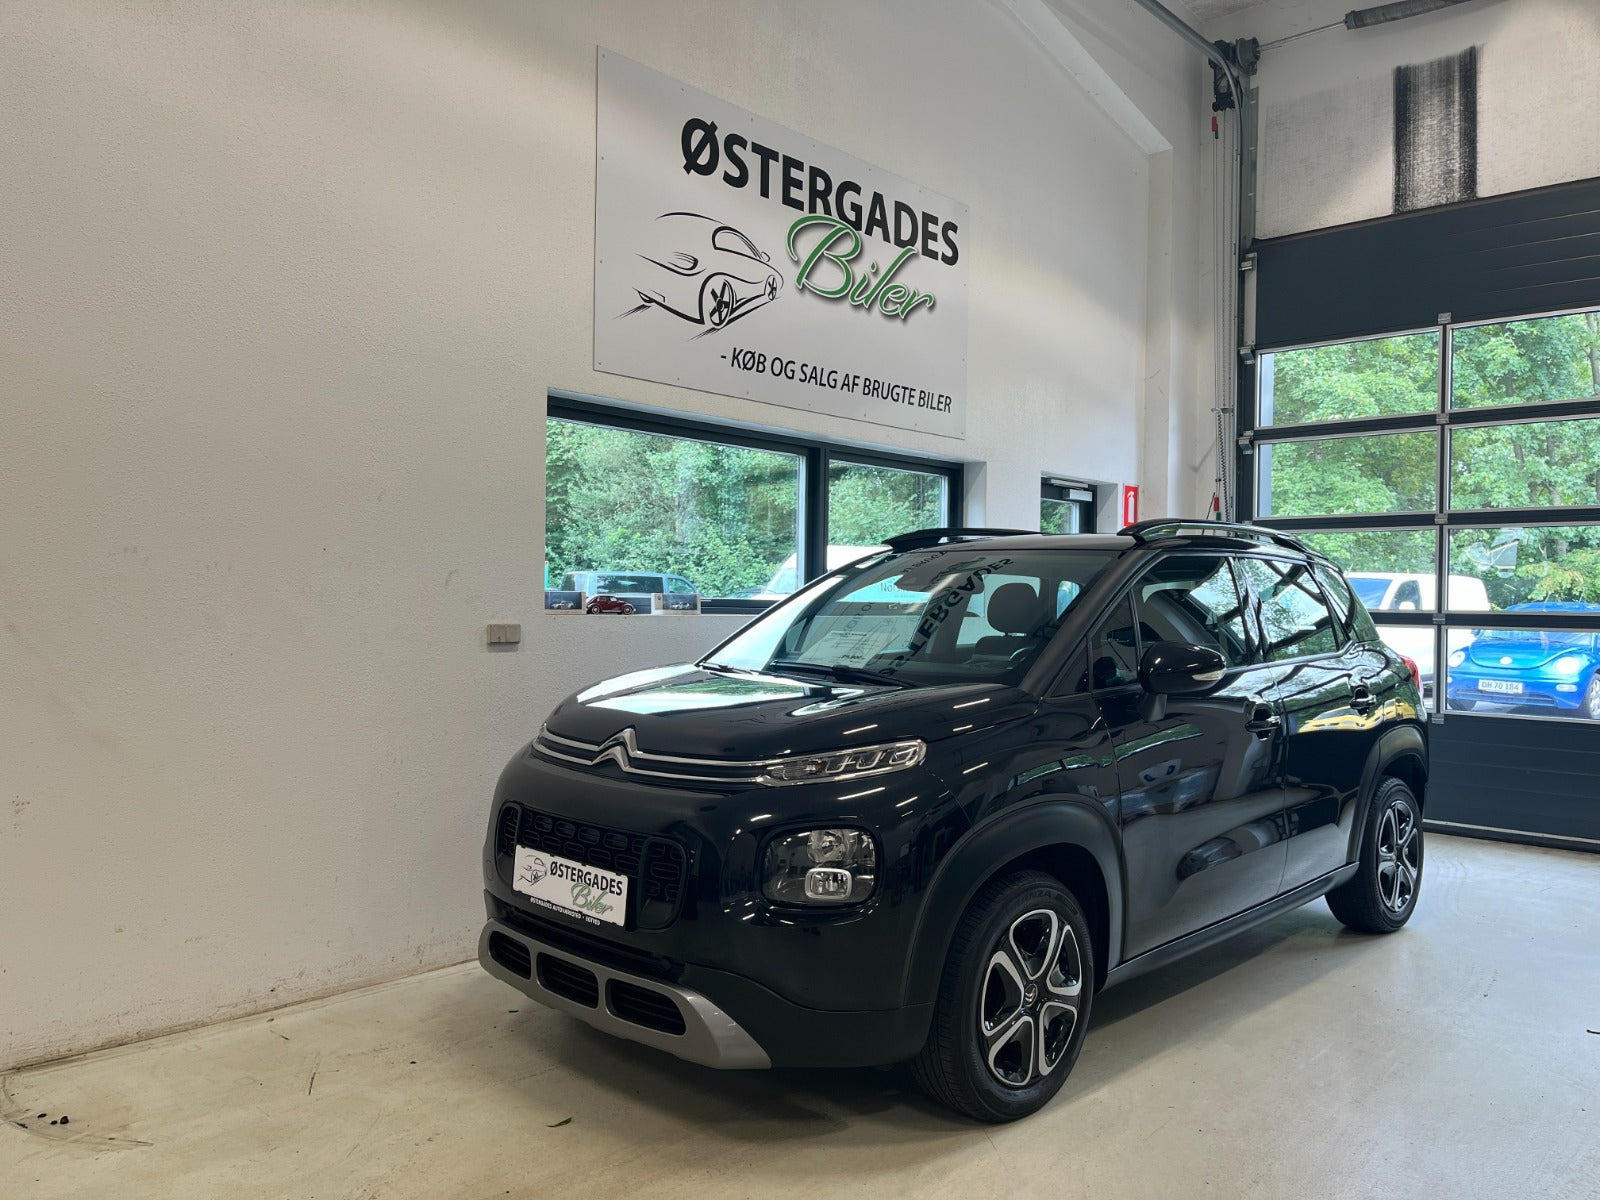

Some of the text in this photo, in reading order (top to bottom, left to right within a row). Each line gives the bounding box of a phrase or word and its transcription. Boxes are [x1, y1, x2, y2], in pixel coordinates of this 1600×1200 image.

[681, 117, 960, 267] ØSTERGADES
[785, 213, 936, 320] Biler
[731, 346, 767, 373] KØB
[770, 355, 797, 381] OG
[798, 362, 839, 390] SALG
[840, 372, 861, 393] AF
[863, 376, 918, 407] BRUGTE
[918, 389, 953, 414] BILER
[550, 861, 623, 896] ØSTERGADES
[570, 881, 614, 915] Biler
